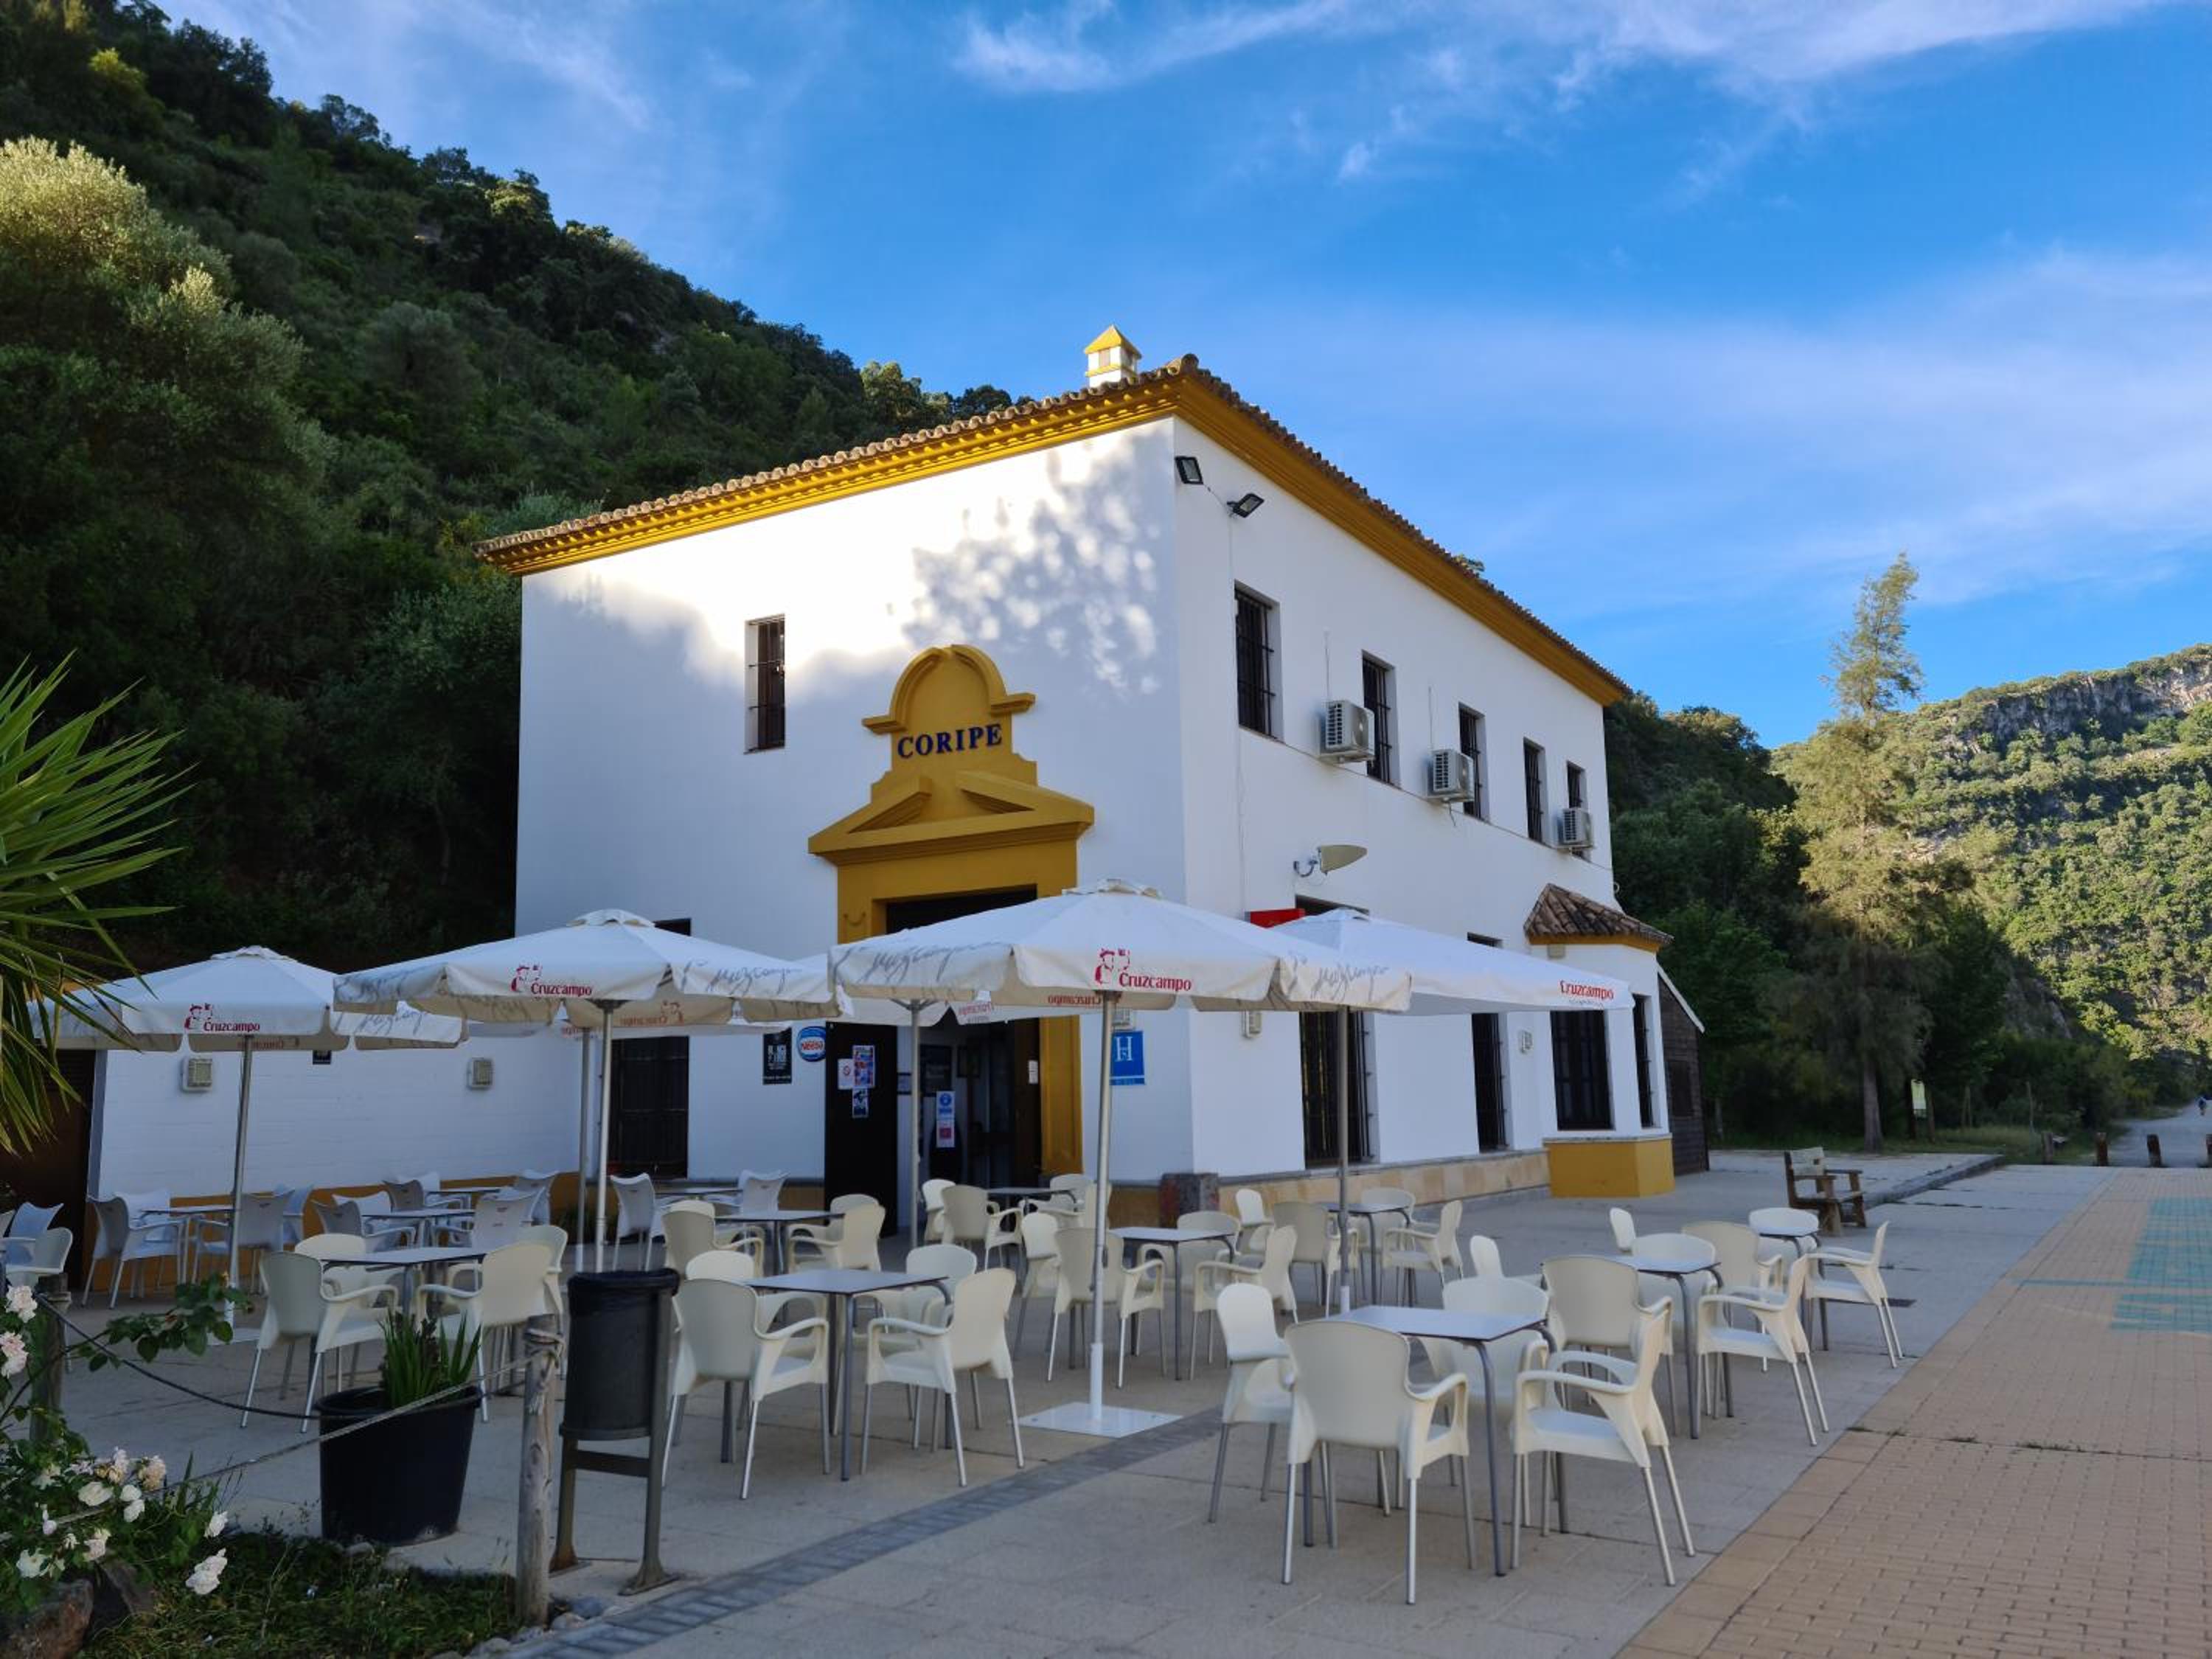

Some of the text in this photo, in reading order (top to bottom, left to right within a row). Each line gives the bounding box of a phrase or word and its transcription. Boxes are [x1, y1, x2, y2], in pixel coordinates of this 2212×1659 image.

[897, 723, 1003, 759] CORIPE
[530, 981, 593, 998] Cruzcampo
[1119, 971, 1192, 992] Cruzcampo
[1559, 979, 1615, 1001] Cruzcampo
[204, 1020, 261, 1033] Cruzcampo
